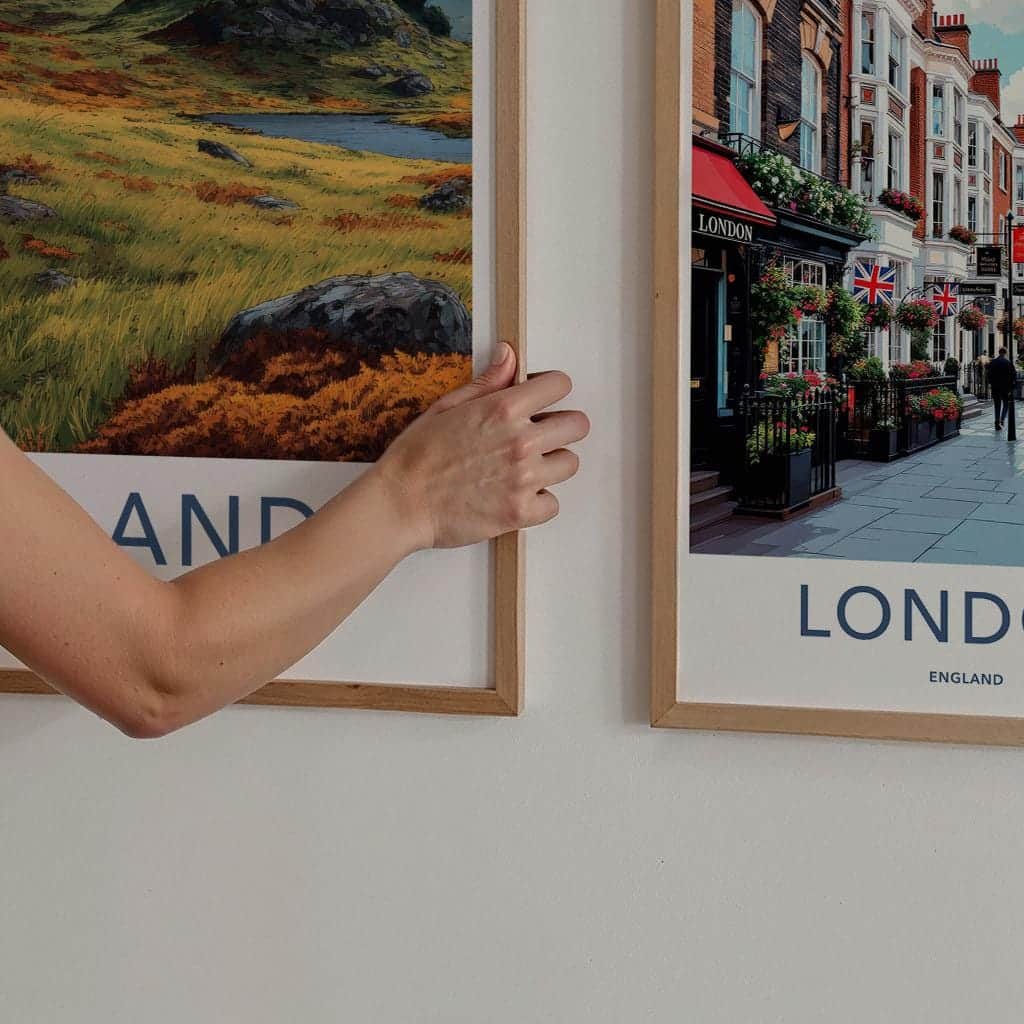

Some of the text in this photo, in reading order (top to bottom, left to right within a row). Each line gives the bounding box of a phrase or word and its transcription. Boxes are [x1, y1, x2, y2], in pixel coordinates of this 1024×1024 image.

[698, 213, 753, 242] LONDON
[800, 584, 1024, 645] LOND
[929, 671, 1004, 686] ENGLAND
